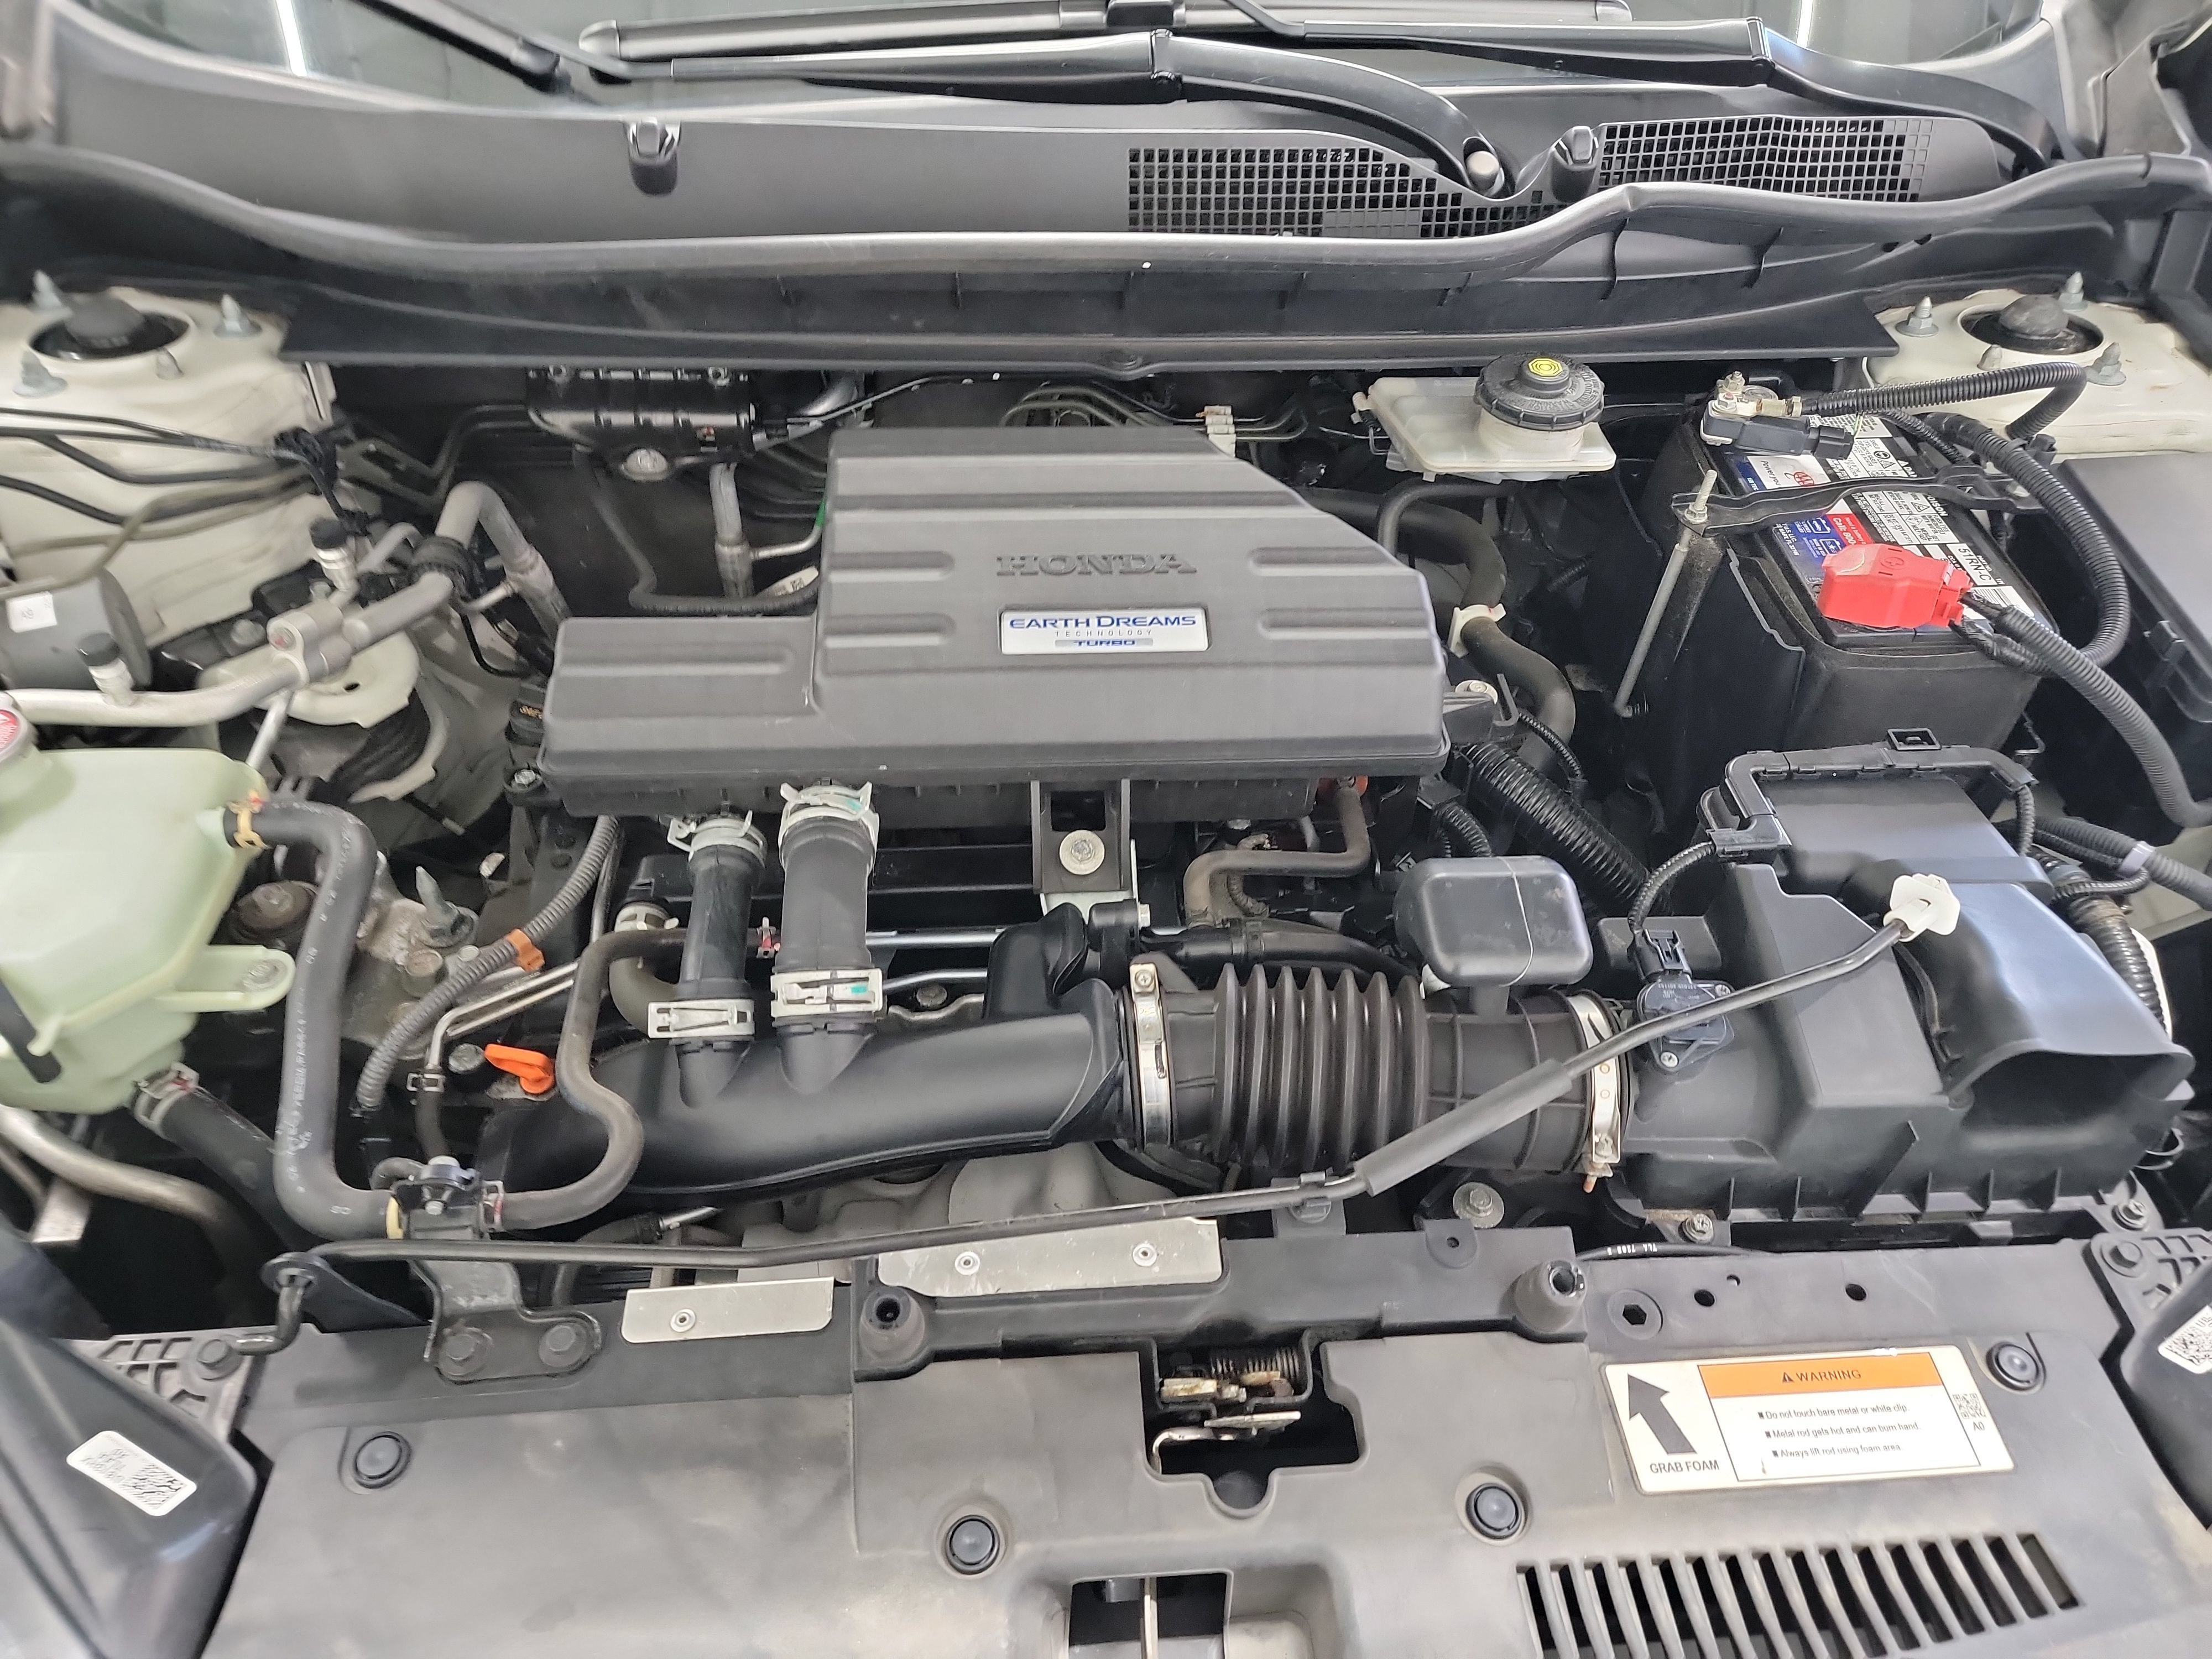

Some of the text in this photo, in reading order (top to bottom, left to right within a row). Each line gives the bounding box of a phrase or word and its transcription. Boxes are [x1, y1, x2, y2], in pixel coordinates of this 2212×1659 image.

[1760, 461, 1777, 476] Power
[1903, 467, 1917, 477] DAN
[1926, 495, 1948, 516] OISON
[1832, 518, 1858, 545] Call: 800-
[1844, 517, 1856, 527] Need
[1851, 530, 1865, 541] battery
[997, 554, 1198, 576] HONDA
[1959, 548, 1992, 581] 51RN-C
[1009, 615, 1196, 629] EARTH DREAMS
[1055, 629, 1152, 637] TECHNOLOGY
[1796, 1369, 1861, 1382] WARNING
[1765, 1411, 1778, 1420] Do
[1780, 1410, 1792, 1419] not
[1794, 1408, 1815, 1418] touch
[1818, 1406, 1835, 1417] bare
[1837, 1406, 1859, 1416] metal
[1772, 1429, 1795, 1438] Metal
[1797, 1428, 1810, 1437] rod
[1812, 1428, 1830, 1438] gets
[1830, 1426, 1845, 1436] hot
[1846, 1426, 1861, 1434] and
[1863, 1425, 1877, 1433] can
[1780, 1449, 1809, 1459] Always
[1822, 1447, 1835, 1455] rod
[1837, 1446, 1859, 1455] using
[1860, 1445, 1881, 1453] foam
[1650, 1459, 1720, 1473] GRAB FOAM
